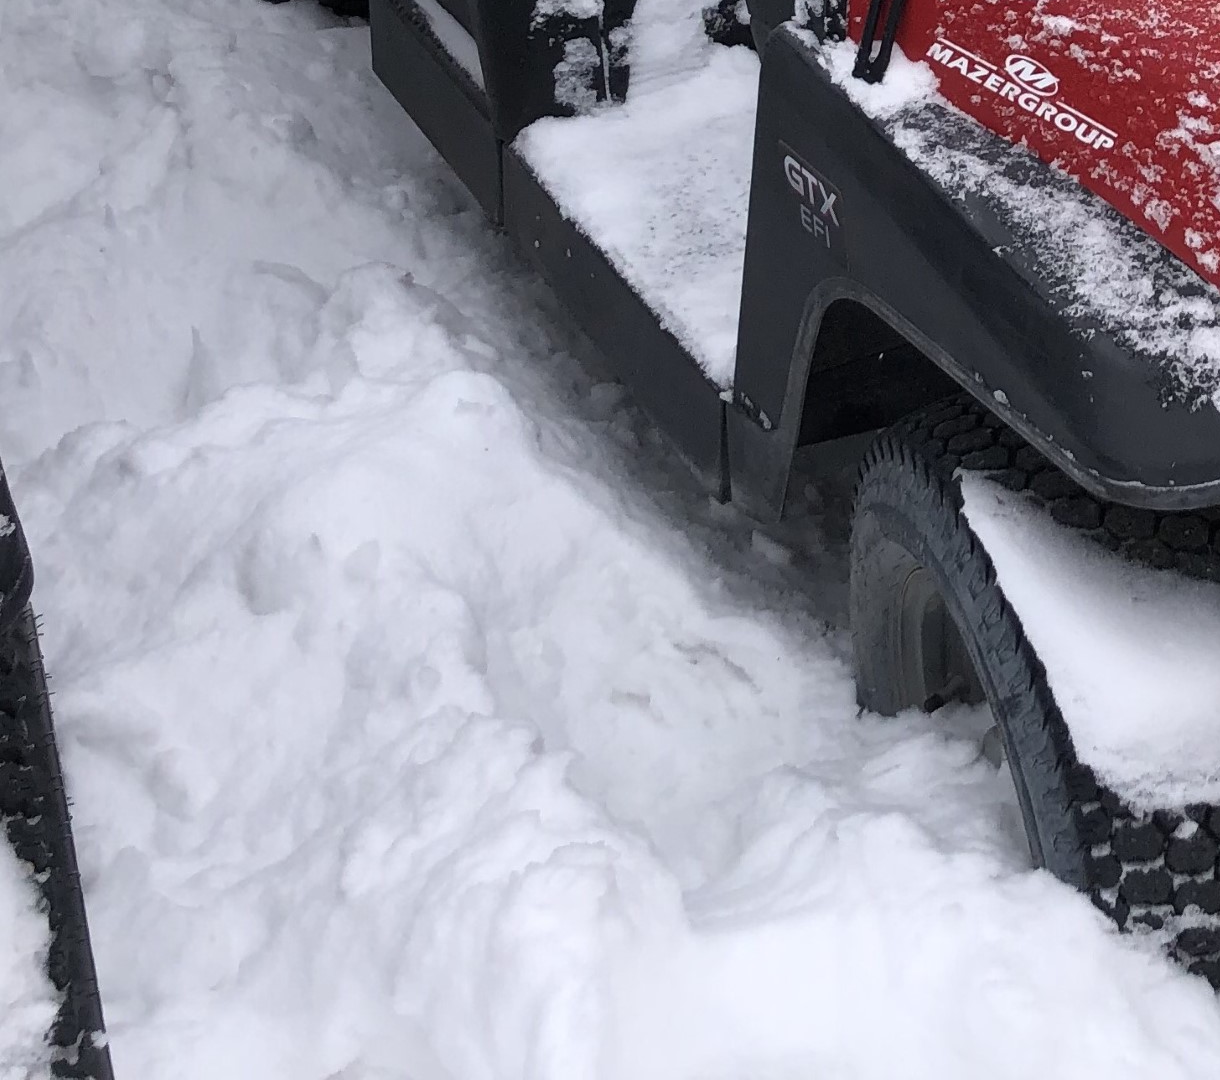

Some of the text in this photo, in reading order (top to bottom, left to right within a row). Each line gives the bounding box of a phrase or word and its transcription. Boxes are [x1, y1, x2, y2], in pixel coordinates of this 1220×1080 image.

[926, 42, 1115, 150] MAZERGROUP
[784, 155, 840, 227] GTX
[800, 203, 831, 249] EFI
